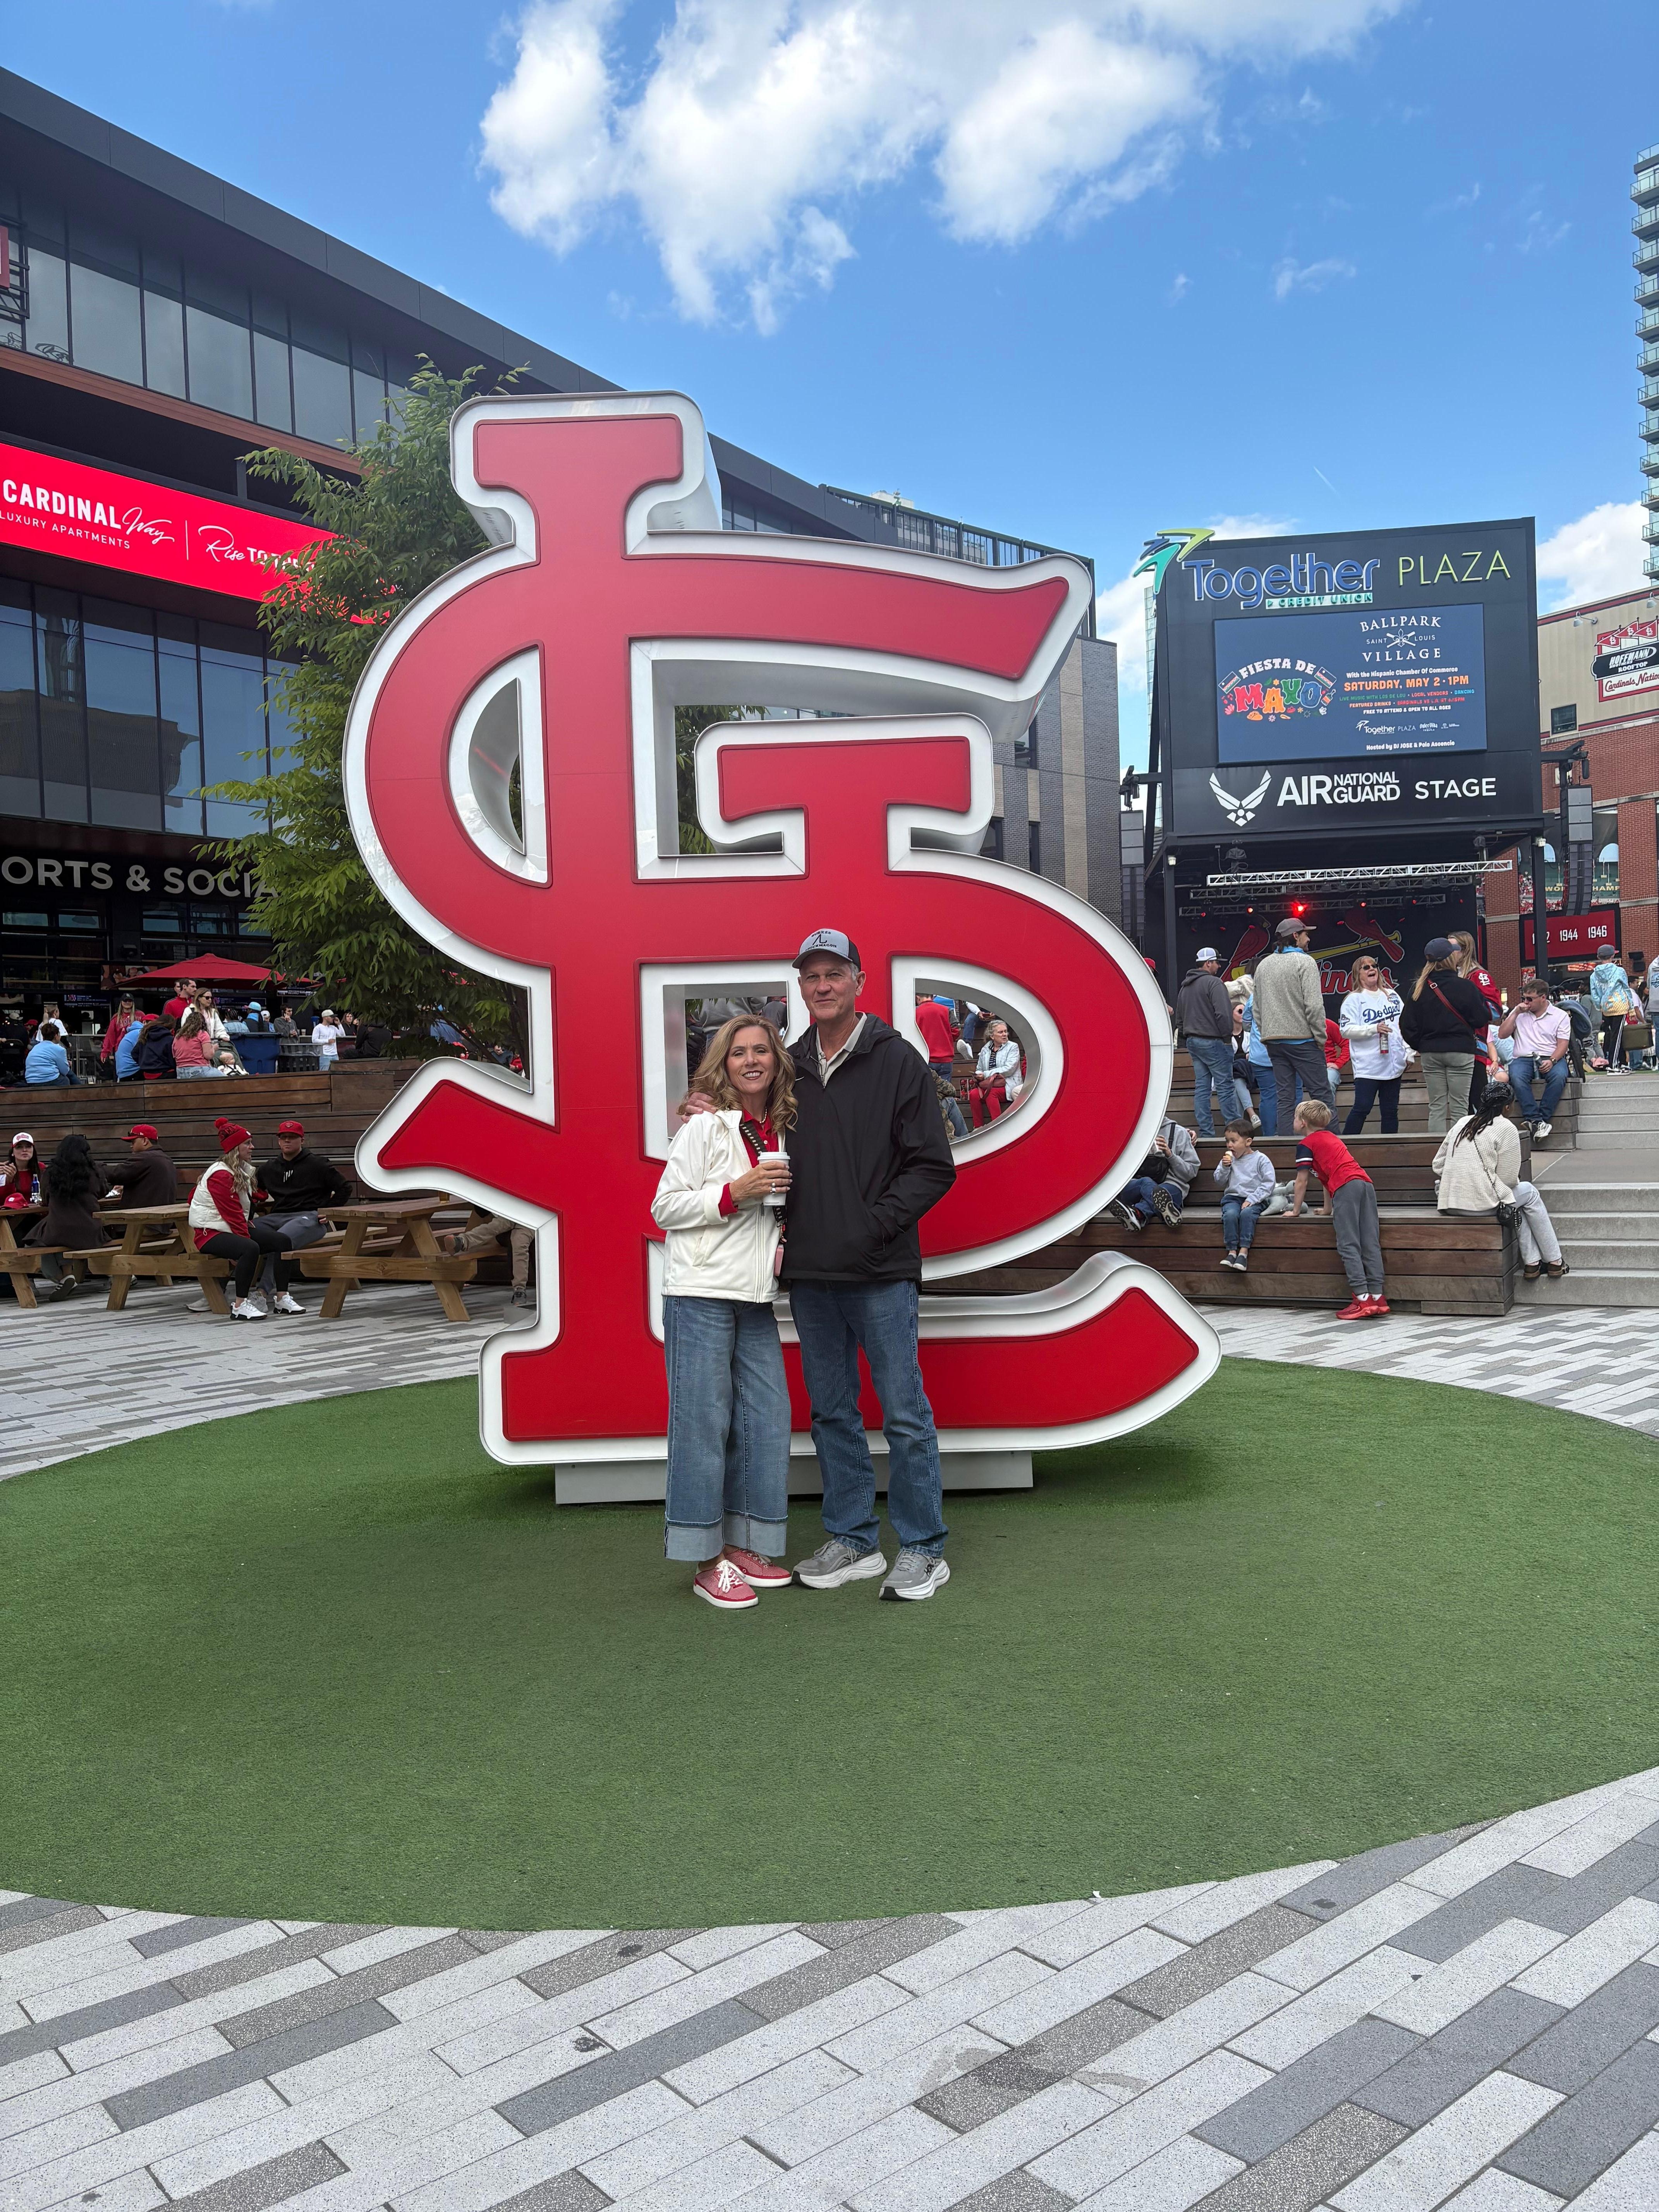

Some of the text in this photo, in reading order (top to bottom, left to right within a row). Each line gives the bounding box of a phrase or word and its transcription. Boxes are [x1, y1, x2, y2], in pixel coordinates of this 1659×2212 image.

[3, 479, 175, 544] CARDINAL Way
[0, 510, 130, 549] LUXURY APARTMENTS
[198, 525, 246, 562] Rise
[1182, 550, 1511, 610] Together PLAZA
[1279, 593, 1372, 607] CREDIT UNION
[1360, 616, 1441, 632] BALLPARK
[1362, 648, 1441, 662] VILLAGE
[1609, 648, 1650, 666] HOFFMANN
[1239, 658, 1316, 679] FIESTA DE
[1371, 669, 1394, 678] Hispanic
[1618, 661, 1648, 673] ROOFTOP
[1344, 675, 1469, 691] SATURDAY, MAY 2 1PM
[1605, 678, 1635, 692] Cardinals
[1234, 678, 1322, 713] MAYO
[1364, 726, 1395, 735] Together
[1277, 771, 1496, 806] AIR NATIONAL STAGE
[1333, 785, 1400, 803] GUARD
[2, 856, 279, 898] ORTS & SOCIA
[1560, 929, 1578, 942] 1944
[1588, 926, 1607, 938] 1946
